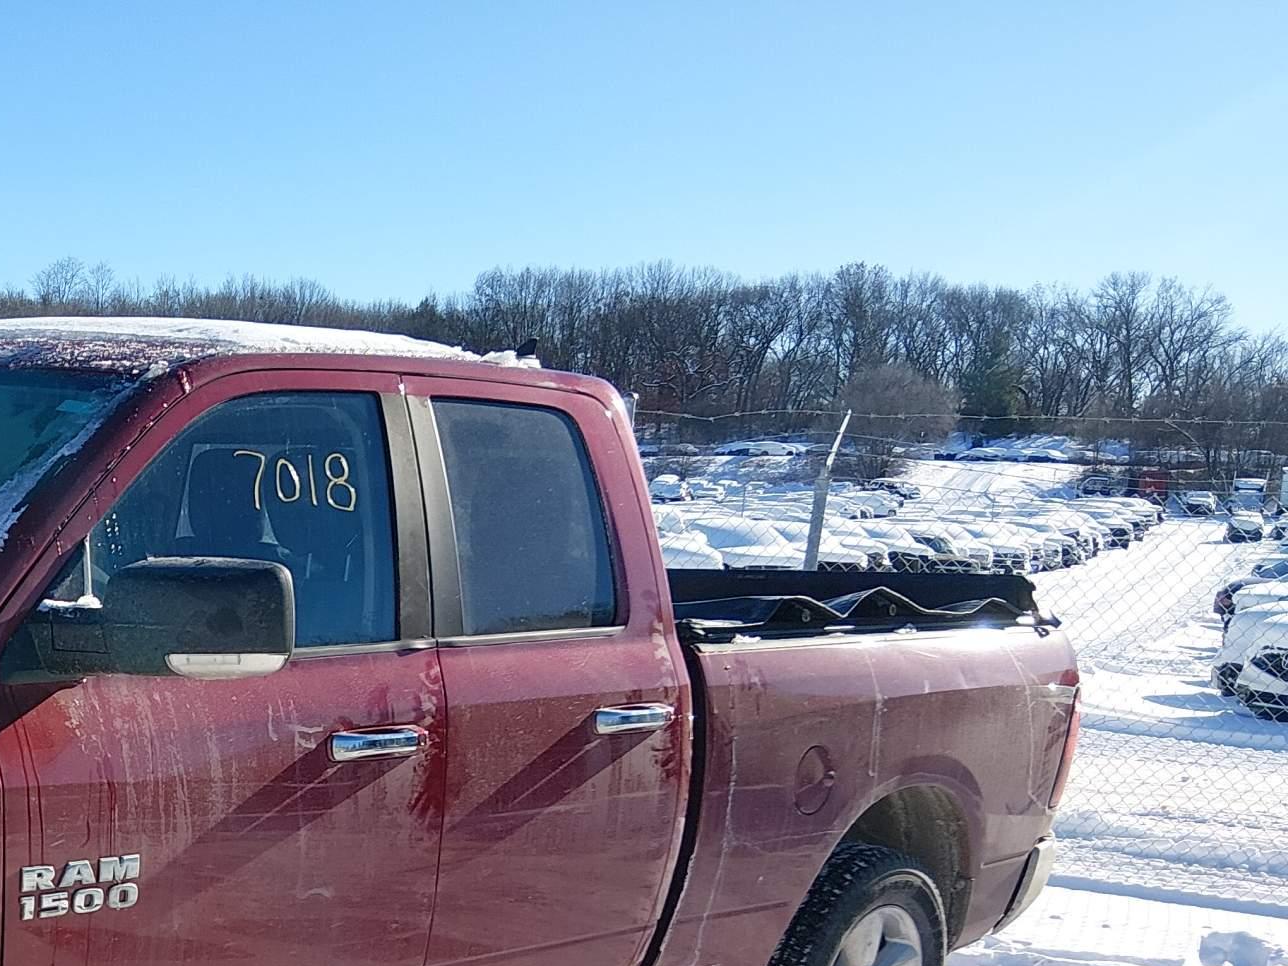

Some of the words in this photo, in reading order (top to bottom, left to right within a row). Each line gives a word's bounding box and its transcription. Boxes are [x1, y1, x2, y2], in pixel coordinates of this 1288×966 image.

[233, 450, 356, 511] 7018
[21, 854, 140, 892] RAM
[19, 882, 139, 921] 1500
